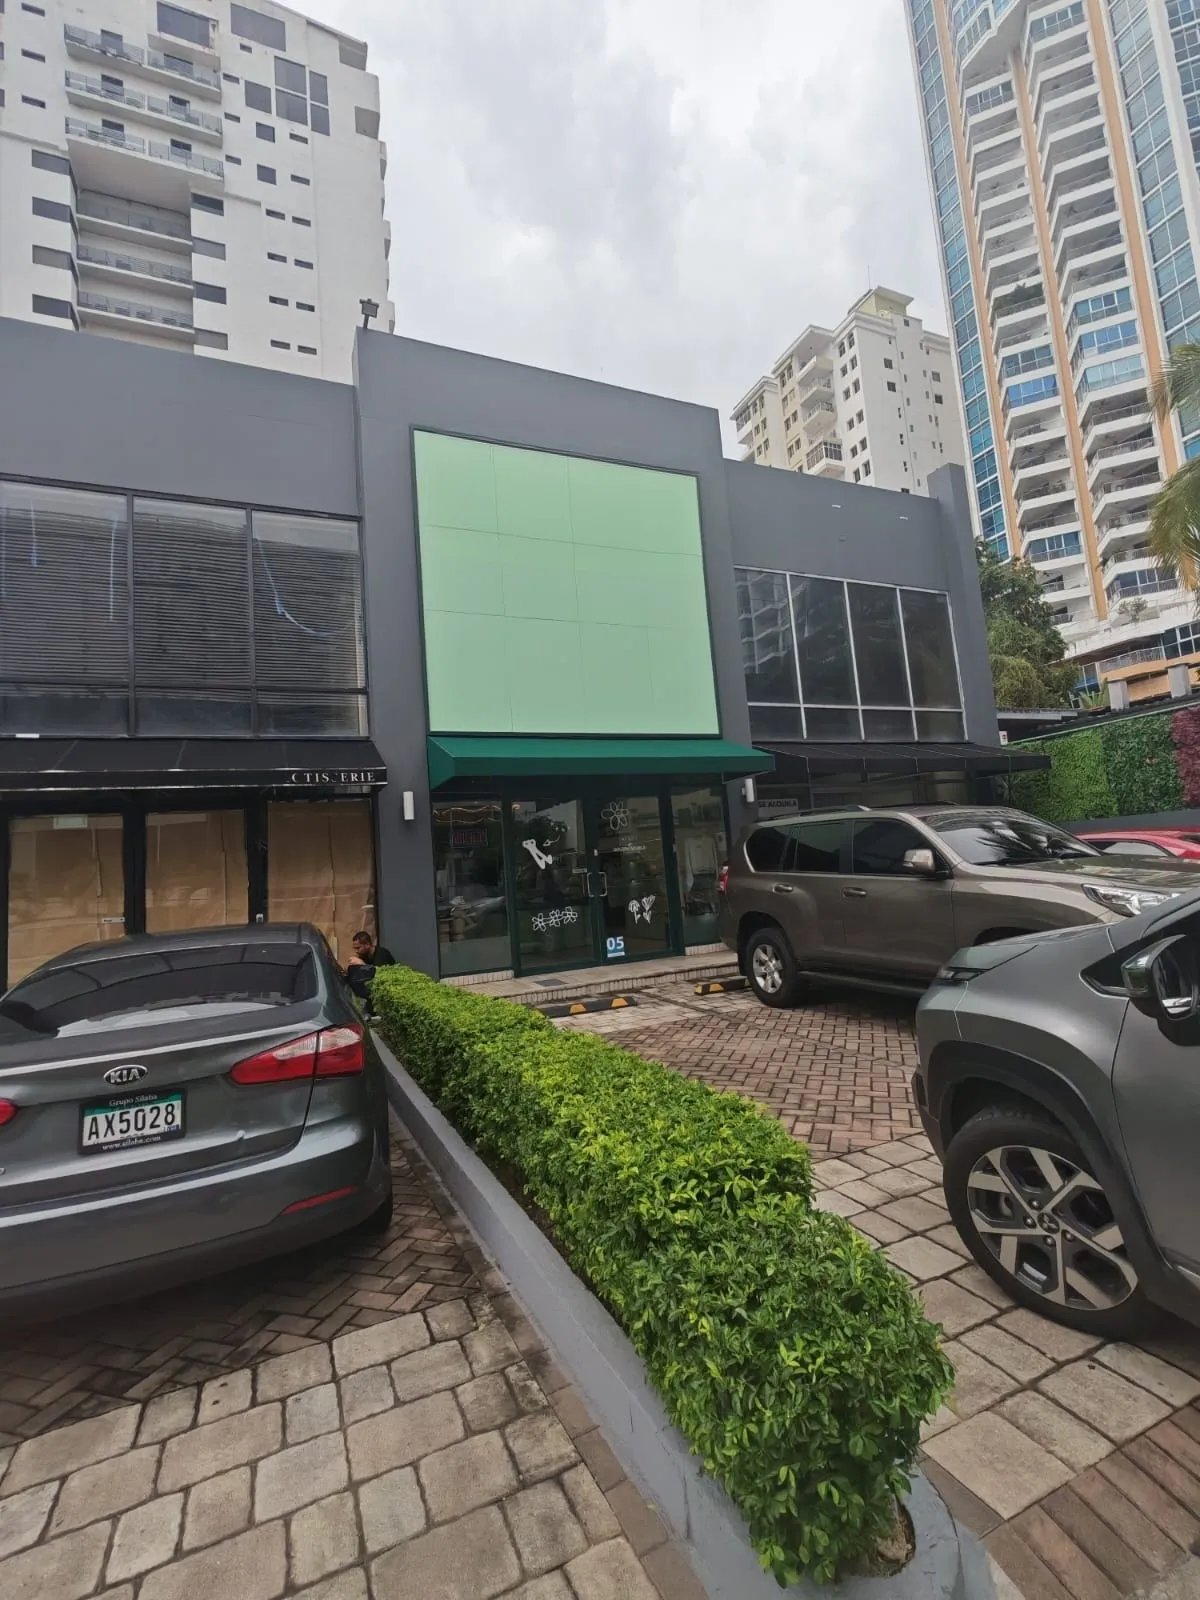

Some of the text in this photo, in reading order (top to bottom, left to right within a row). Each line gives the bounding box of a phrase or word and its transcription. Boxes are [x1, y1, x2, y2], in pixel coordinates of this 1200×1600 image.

[606, 935, 625, 951] 05
[110, 1069, 140, 1083] KIA
[87, 1103, 176, 1141] AX5028
